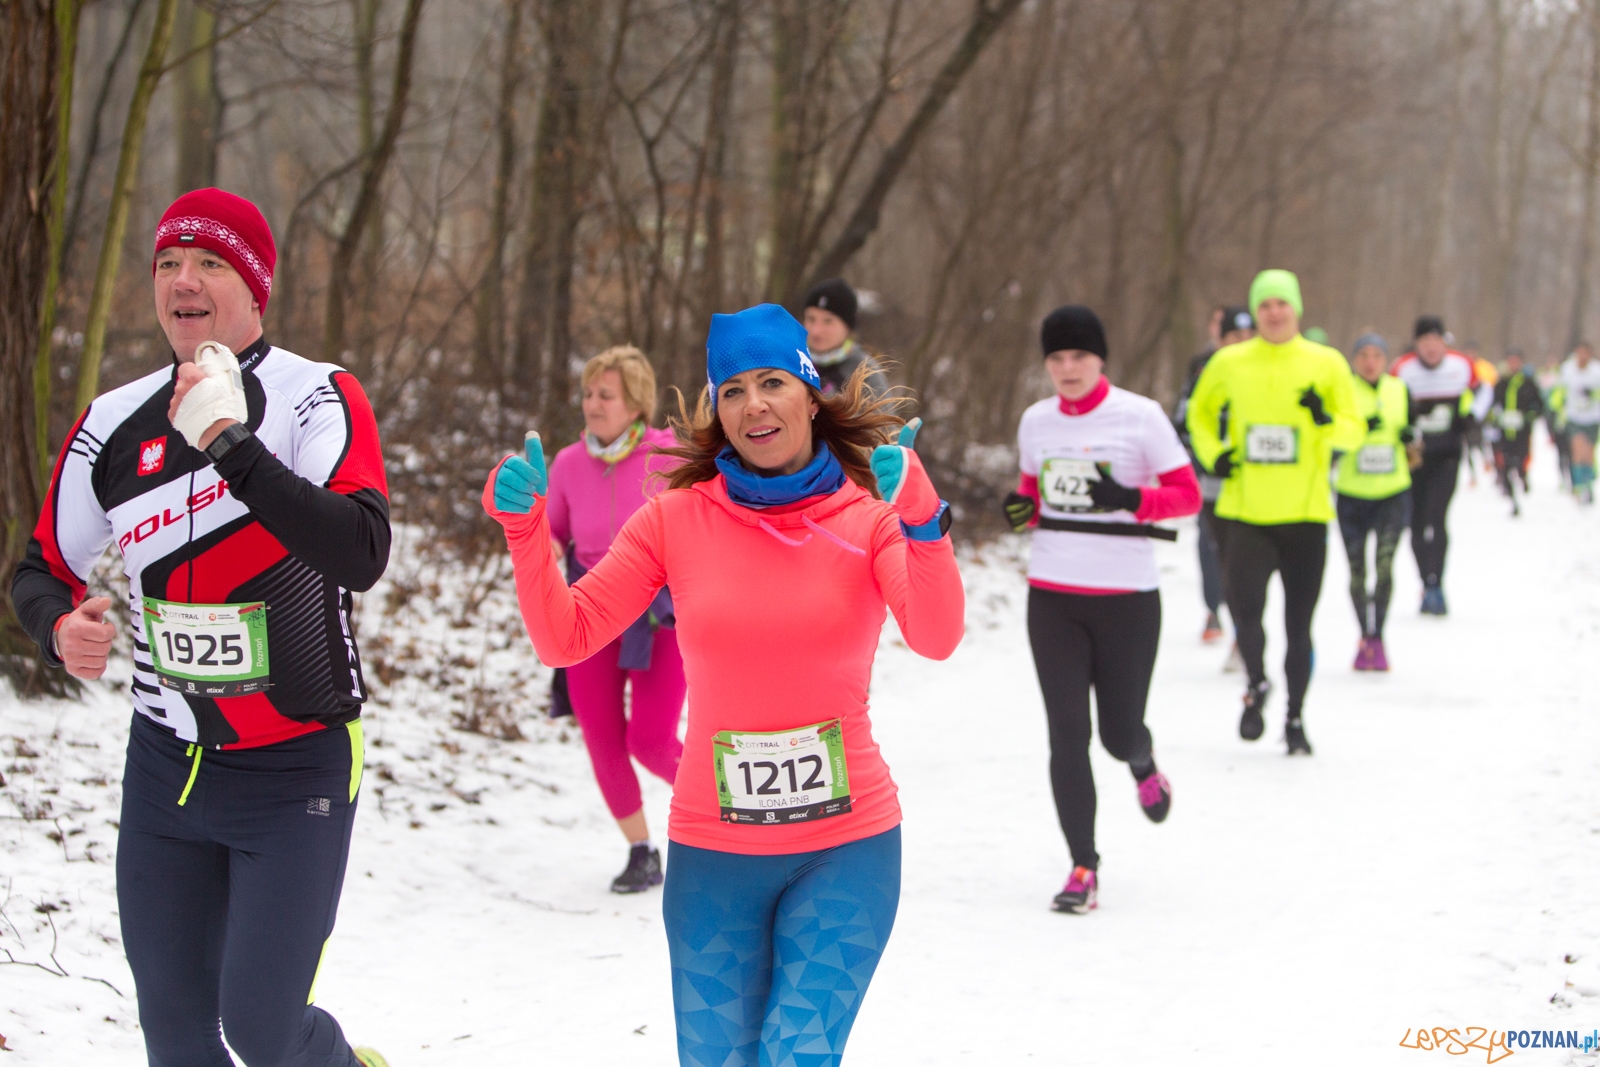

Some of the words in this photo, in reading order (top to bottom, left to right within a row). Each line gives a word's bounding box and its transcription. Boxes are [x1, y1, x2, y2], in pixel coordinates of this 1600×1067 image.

[239, 352, 259, 371] SKA
[118, 479, 229, 557] POLSK
[161, 631, 243, 666] 1925
[255, 637, 263, 667] Poznań
[338, 586, 362, 699] LSKA
[738, 754, 826, 796] 1212
[835, 756, 844, 787] Poznań
[758, 797, 789, 808] ILONA
[790, 795, 810, 806] PNB
